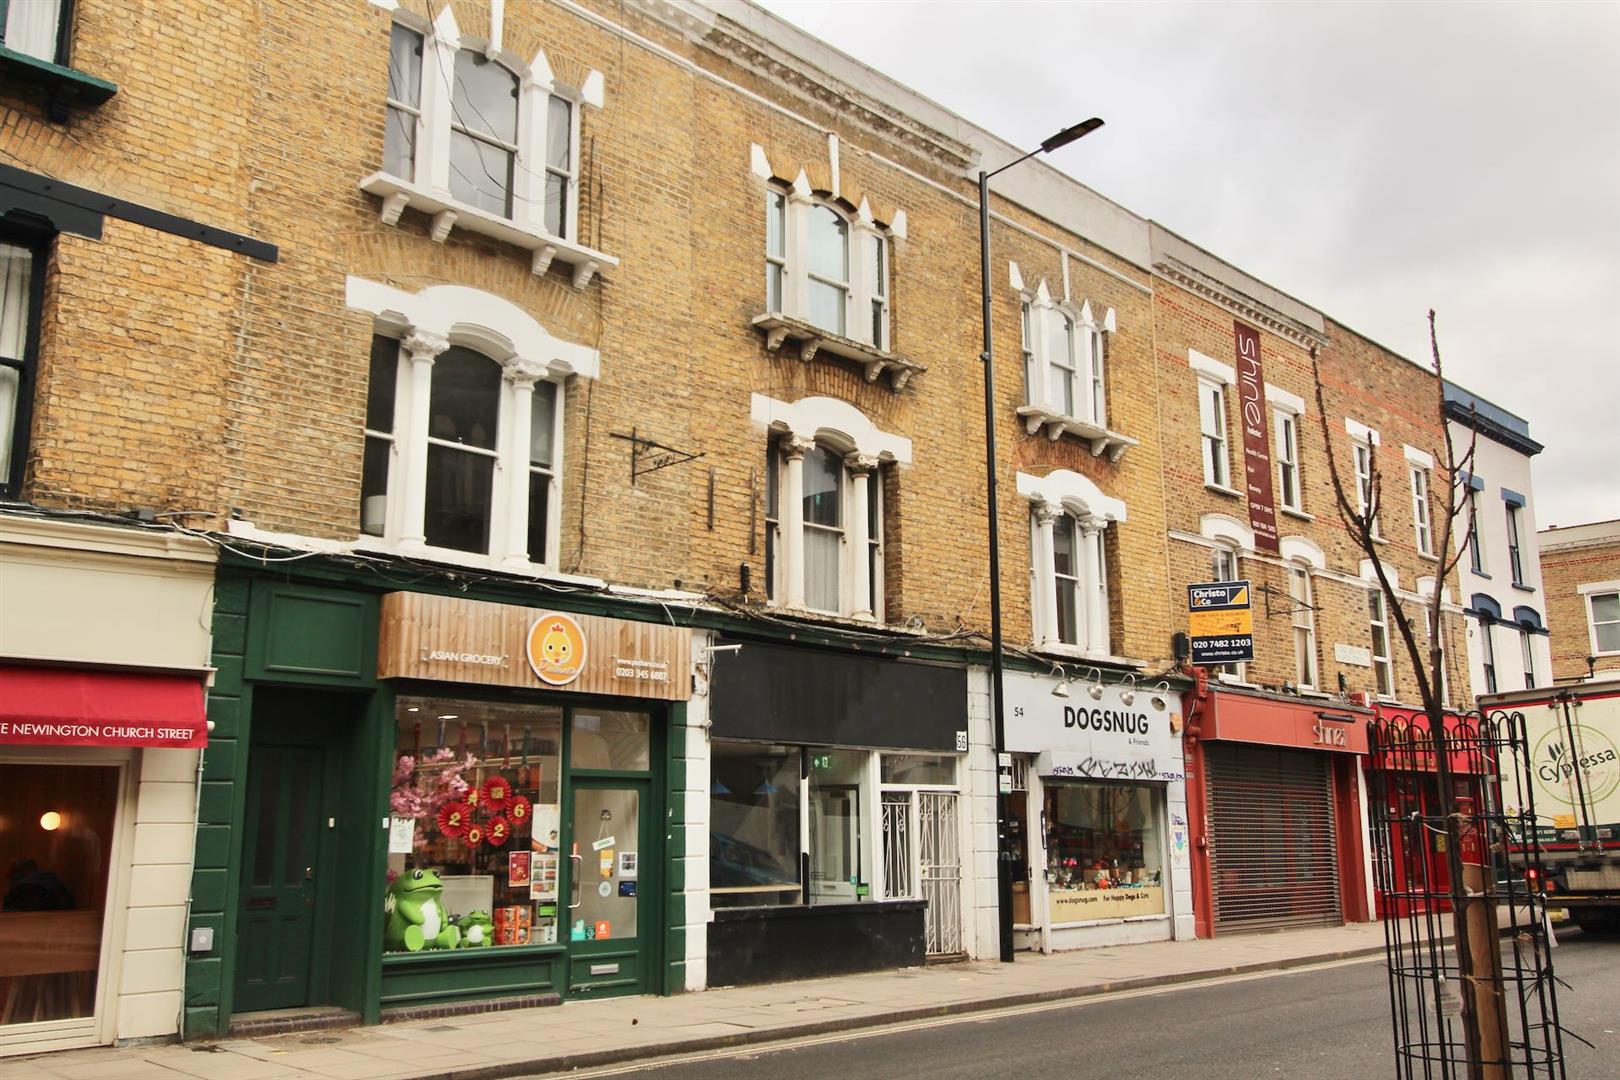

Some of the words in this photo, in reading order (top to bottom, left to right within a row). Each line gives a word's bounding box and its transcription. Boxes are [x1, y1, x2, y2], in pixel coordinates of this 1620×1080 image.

[1193, 590, 1226, 598] Christo
[1193, 641, 1208, 649] 020
[1210, 640, 1229, 648] 7482
[1231, 639, 1251, 647] 1203
[430, 650, 459, 662] ASIAN
[460, 653, 503, 666] GROCERY
[616, 667, 634, 678] 0203
[635, 669, 649, 679] 345
[1014, 706, 1024, 717] 54
[1064, 706, 1149, 735] DOGSNUG
[12, 723, 99, 738] NEWINGTON
[103, 725, 154, 739] CHURCH
[157, 727, 194, 740] STREET
[1056, 896, 1097, 905] www.dogsnug.com
[1111, 894, 1124, 902] Happy
[1125, 893, 1136, 901] Dogs
